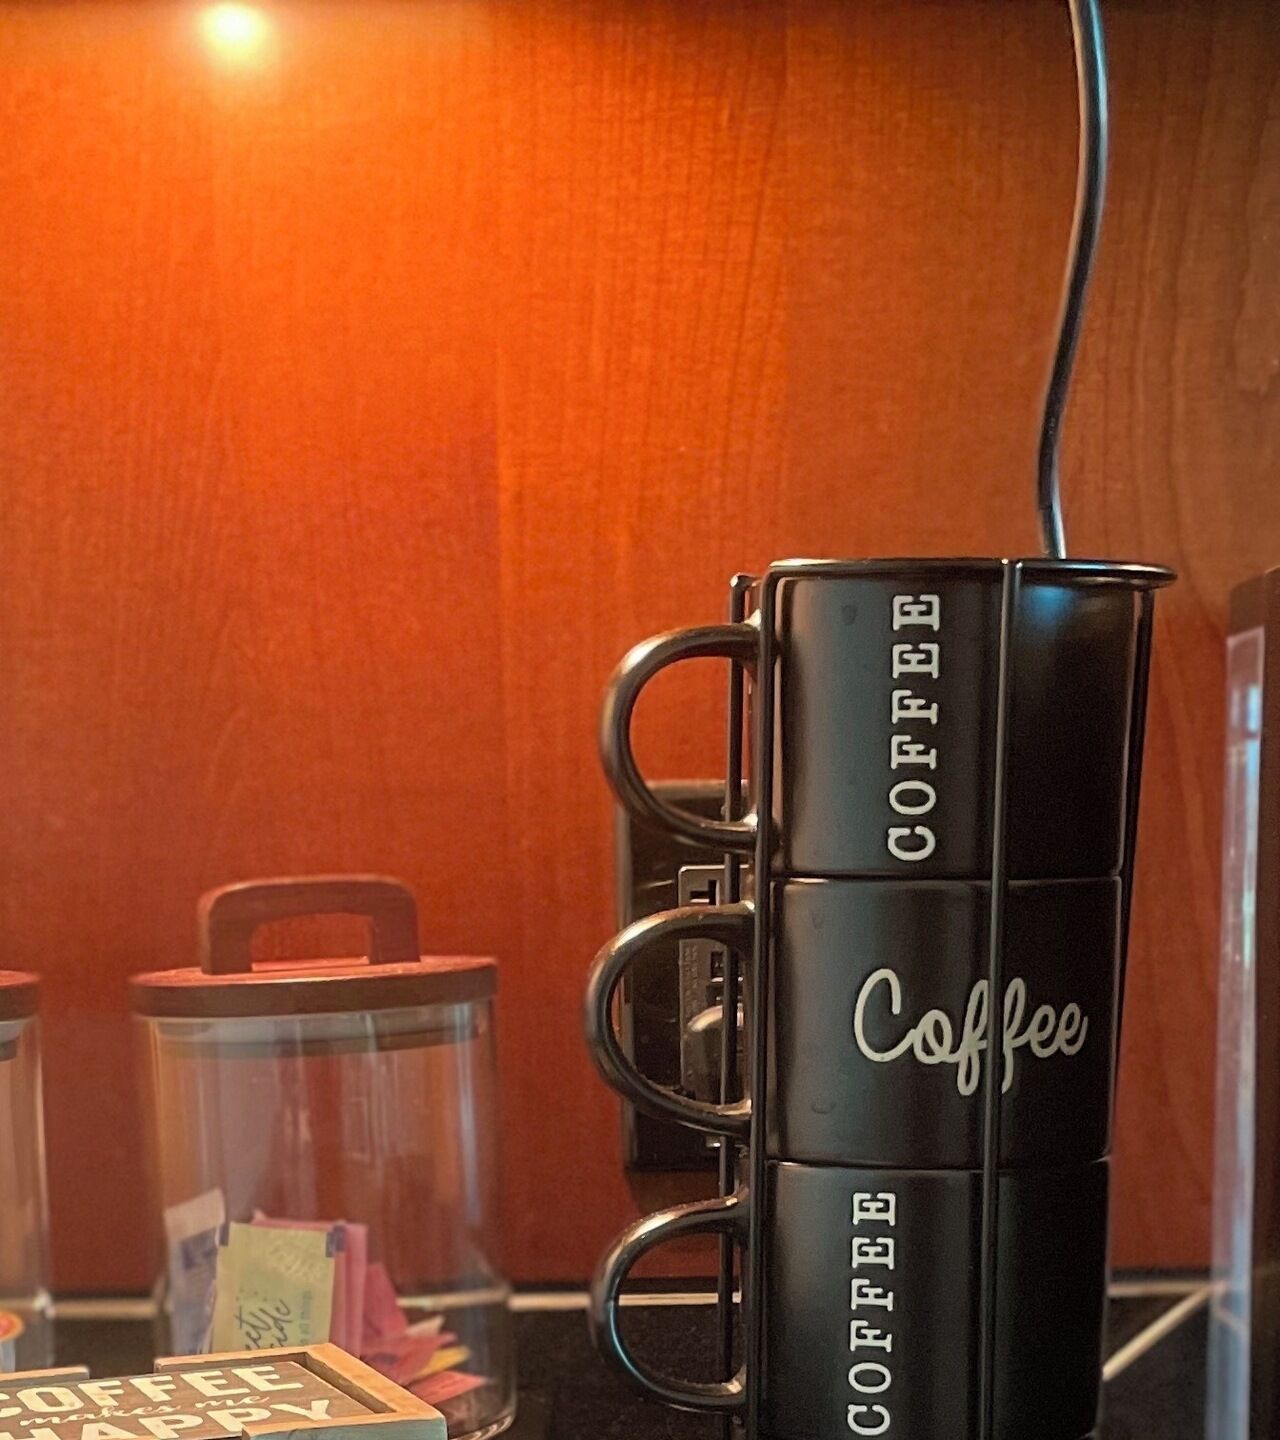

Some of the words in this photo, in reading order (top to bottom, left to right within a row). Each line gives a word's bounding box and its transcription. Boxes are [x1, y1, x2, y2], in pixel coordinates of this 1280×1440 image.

[888, 593, 941, 861] COFFEE
[854, 968, 1088, 1096] Coffee
[847, 1192, 897, 1437] COFFEE
[20, 1403, 181, 1427] makes
[195, 1394, 271, 1409] me
